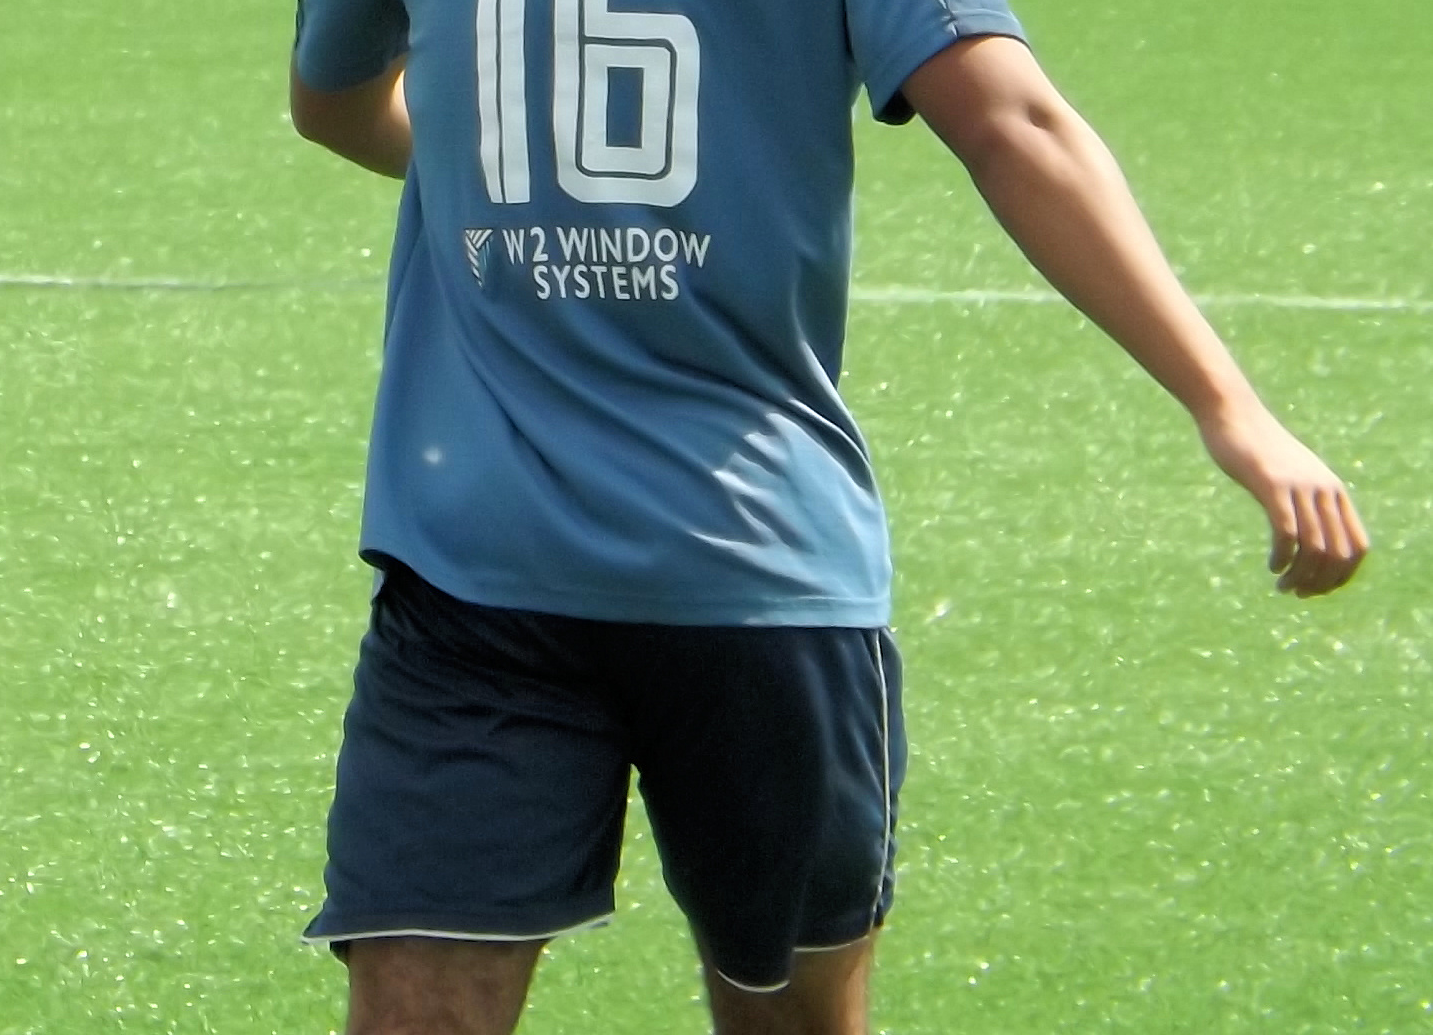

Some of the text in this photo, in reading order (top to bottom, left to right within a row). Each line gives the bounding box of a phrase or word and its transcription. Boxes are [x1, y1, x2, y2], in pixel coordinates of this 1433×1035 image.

[502, 227, 711, 267] W2 WINDOW
[535, 265, 679, 300] SYSTEMS
